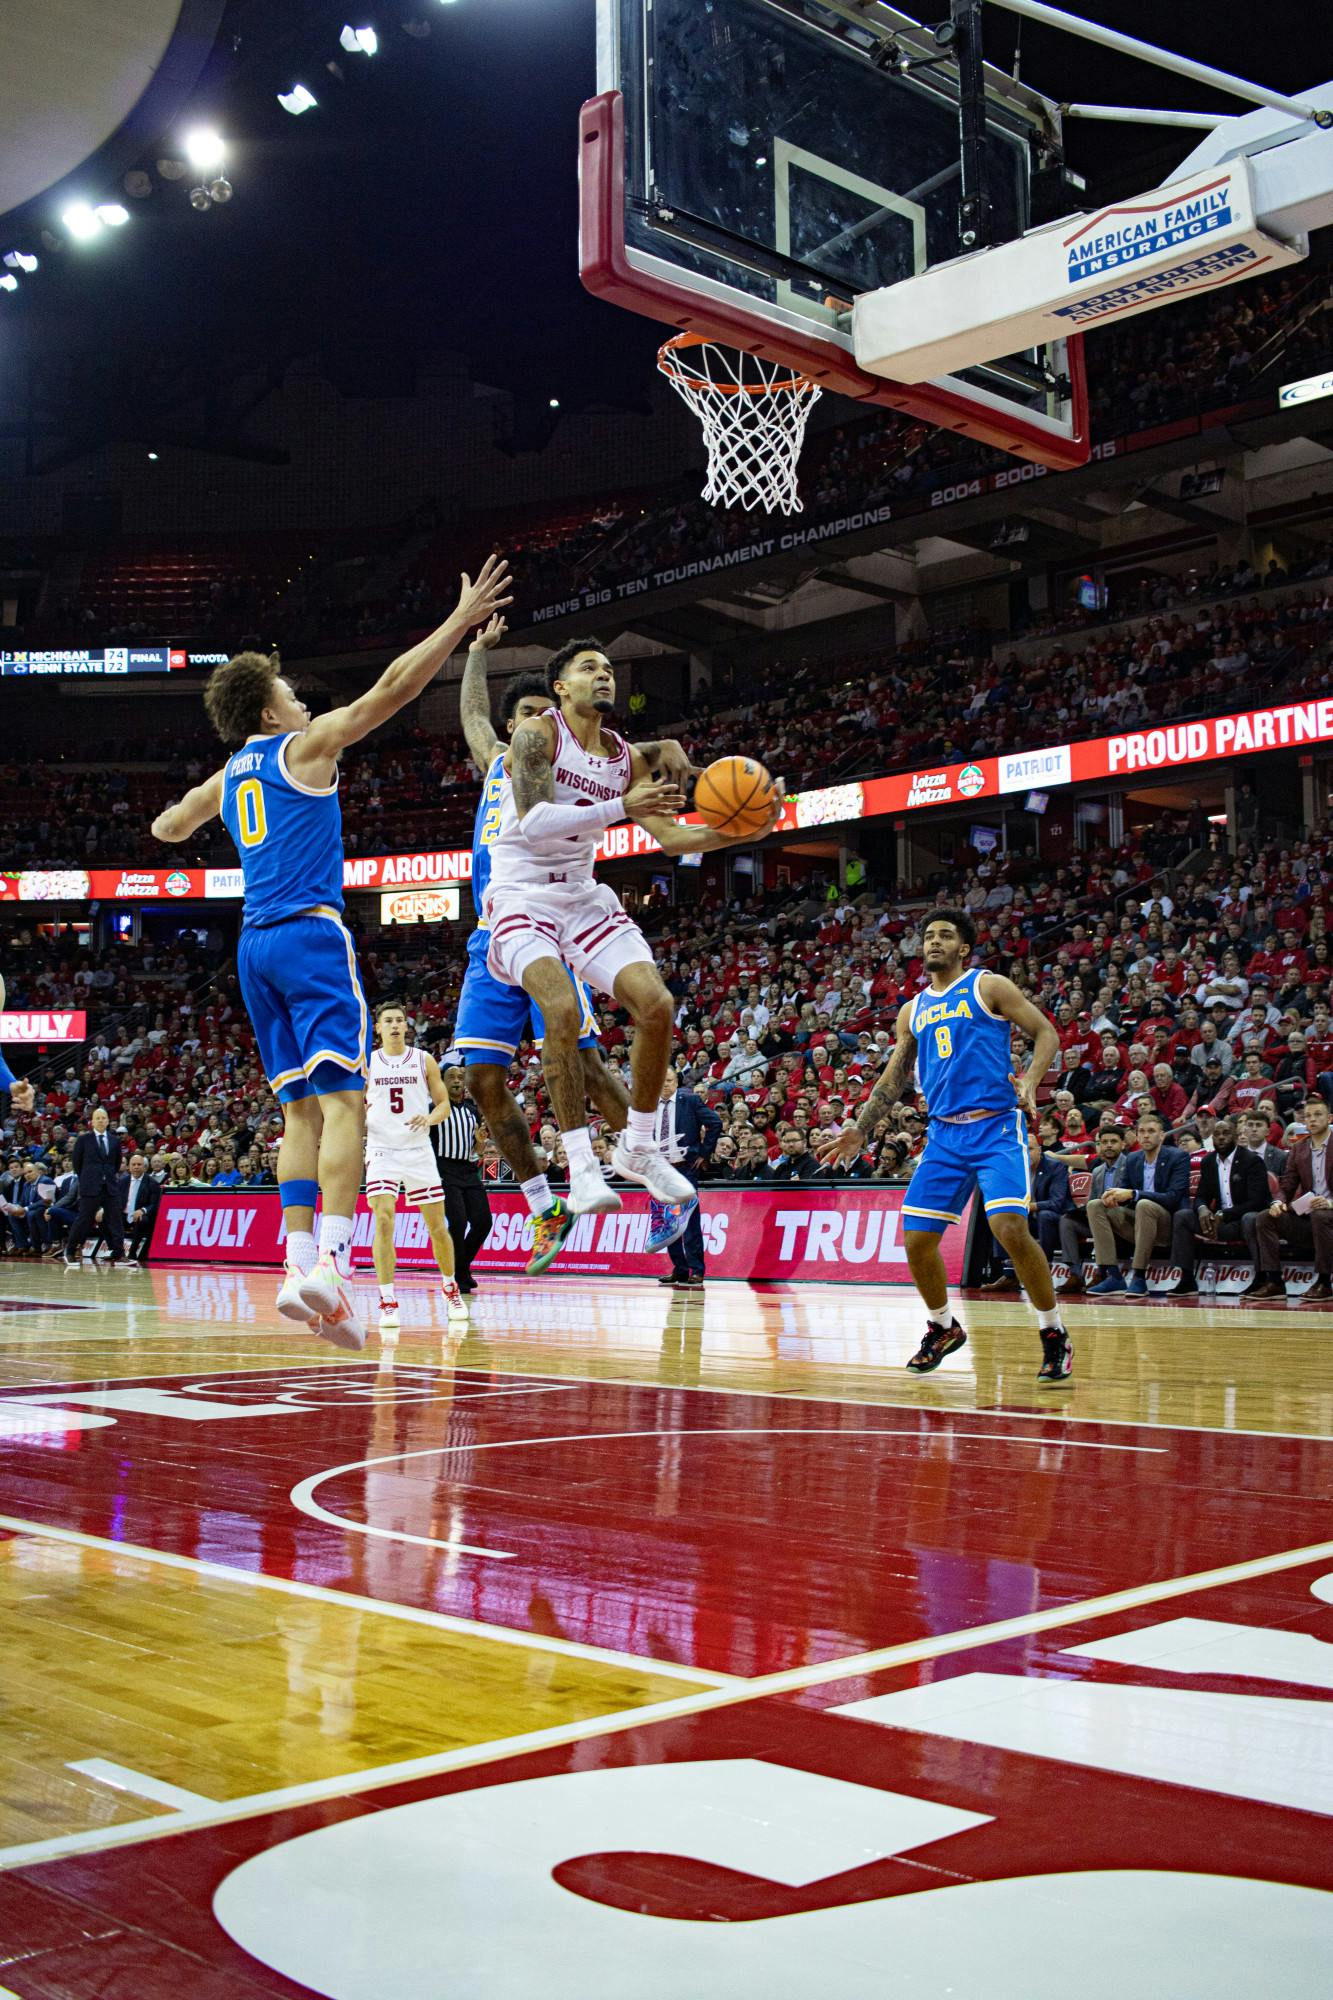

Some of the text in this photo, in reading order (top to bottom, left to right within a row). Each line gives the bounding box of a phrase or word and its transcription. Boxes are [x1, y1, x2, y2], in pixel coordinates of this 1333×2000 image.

[1068, 188, 1228, 264] AMERICAN FAMILY
[1080, 214, 1218, 275] INSURANCE
[1070, 251, 1258, 321] AMERICAN FAMILY
[1071, 250, 1232, 312] INSURANCE
[1092, 440, 1115, 459] 15
[931, 480, 981, 506] 2004
[533, 506, 891, 622] MEN'S BIG TEN TOURNAMENT CHAMPIONS
[29, 651, 89, 661] MICHIGAN
[108, 651, 124, 659] 74
[29, 662, 124, 673] PENN STATE 72
[130, 654, 162, 663] FINAL
[189, 655, 229, 663] TOYOTA
[1108, 723, 1208, 772] PROUD
[230, 753, 264, 778] PERRY
[1006, 754, 1062, 779] PATRIOT
[236, 778, 268, 848] 0
[213, 875, 244, 888] PATR
[343, 852, 472, 886] MP AROUND
[393, 896, 448, 917] COUSINS
[916, 1000, 973, 1033] UCLA
[935, 1026, 952, 1059] 8
[374, 1076, 418, 1086] WISCONSIN
[390, 1087, 404, 1114] 5
[166, 1208, 257, 1247] TRULY
[776, 1210, 909, 1264] TRUL
